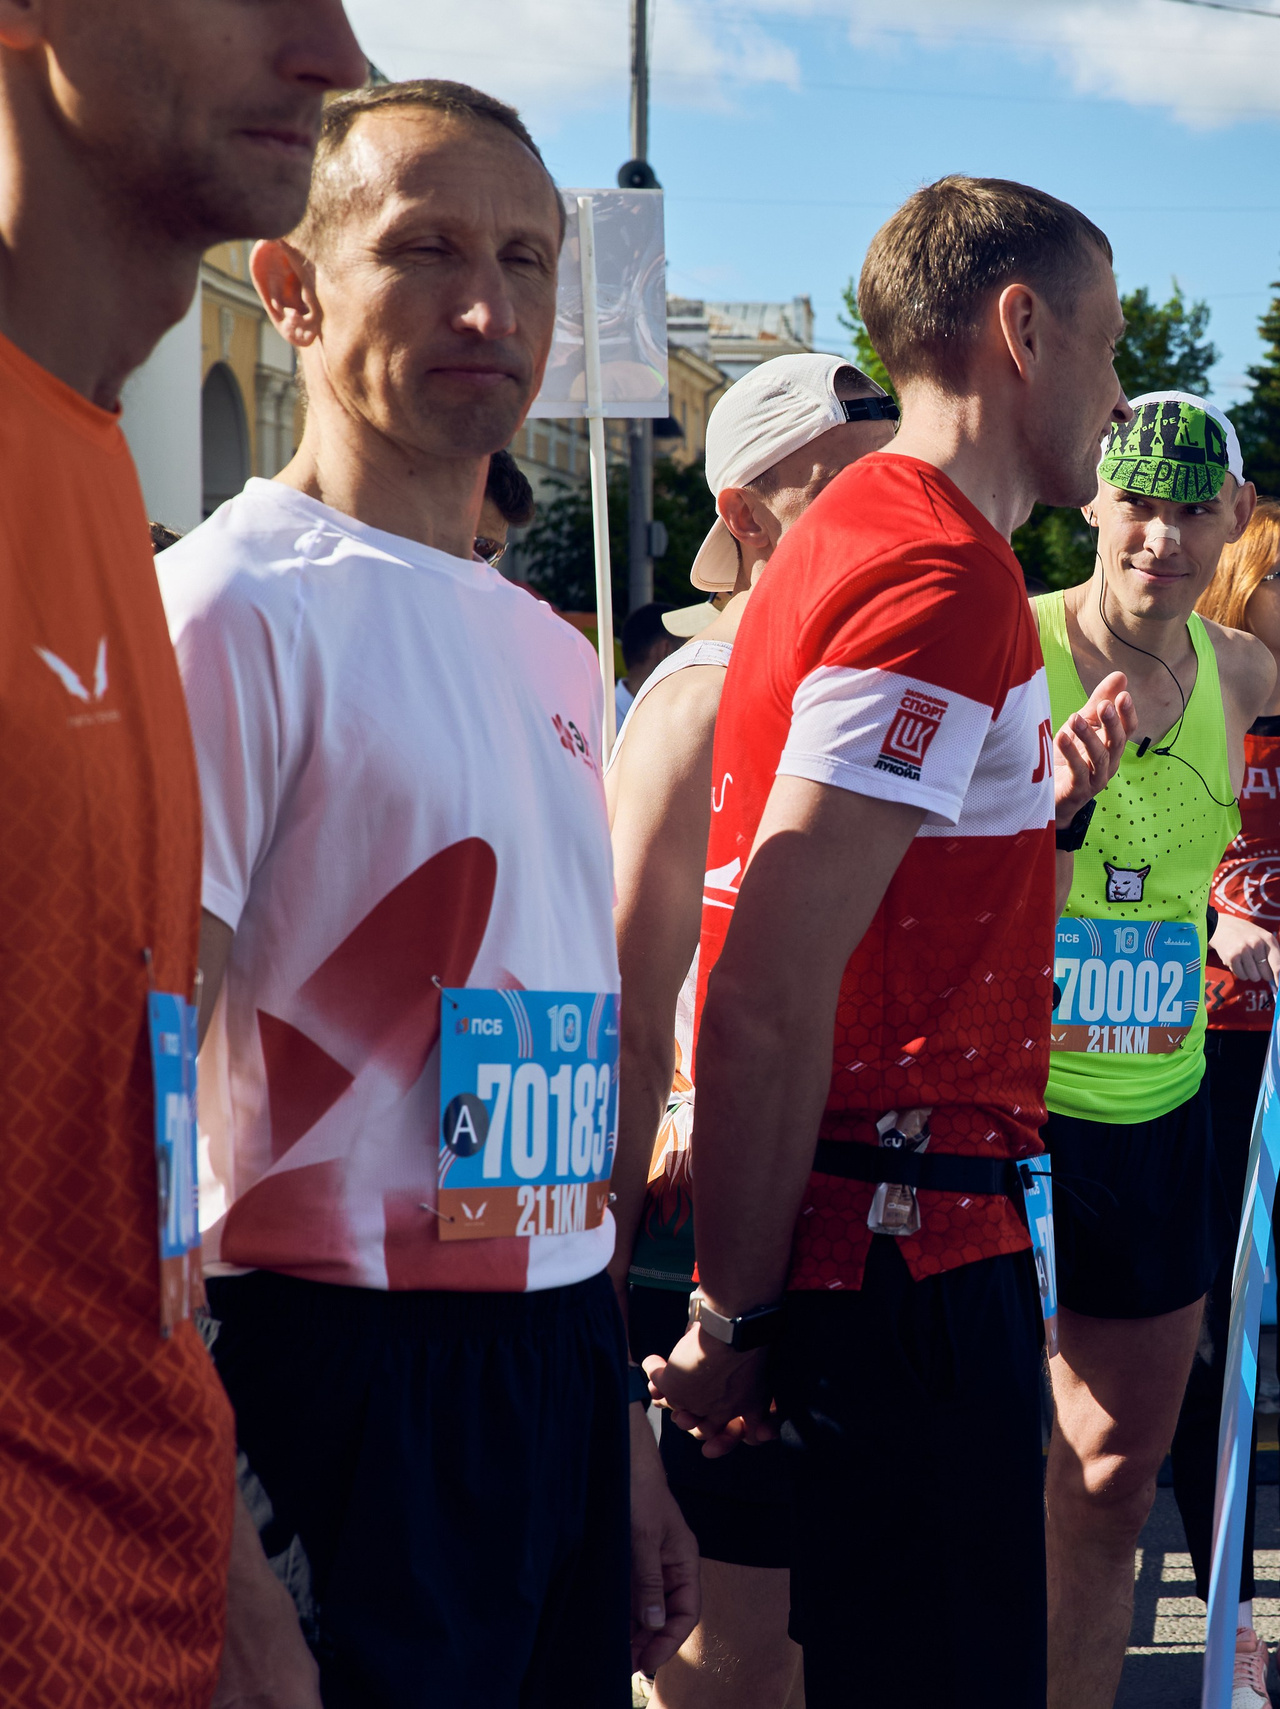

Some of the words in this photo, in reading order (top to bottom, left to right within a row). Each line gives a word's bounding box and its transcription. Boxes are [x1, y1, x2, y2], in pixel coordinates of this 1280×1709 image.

[1110, 457, 1213, 501] ТЕРПИ
[900, 696, 946, 721] СПОРТ
[873, 760, 921, 781] ЛУКОЙЛ
[1057, 933, 1080, 944] ПСБ
[1113, 926, 1140, 954] 10
[1055, 957, 1184, 1023] 70002
[471, 1018, 503, 1036] ПСБ
[547, 1003, 582, 1052] 10
[476, 1062, 610, 1180] 70183
[883, 1136, 903, 1148] GU
